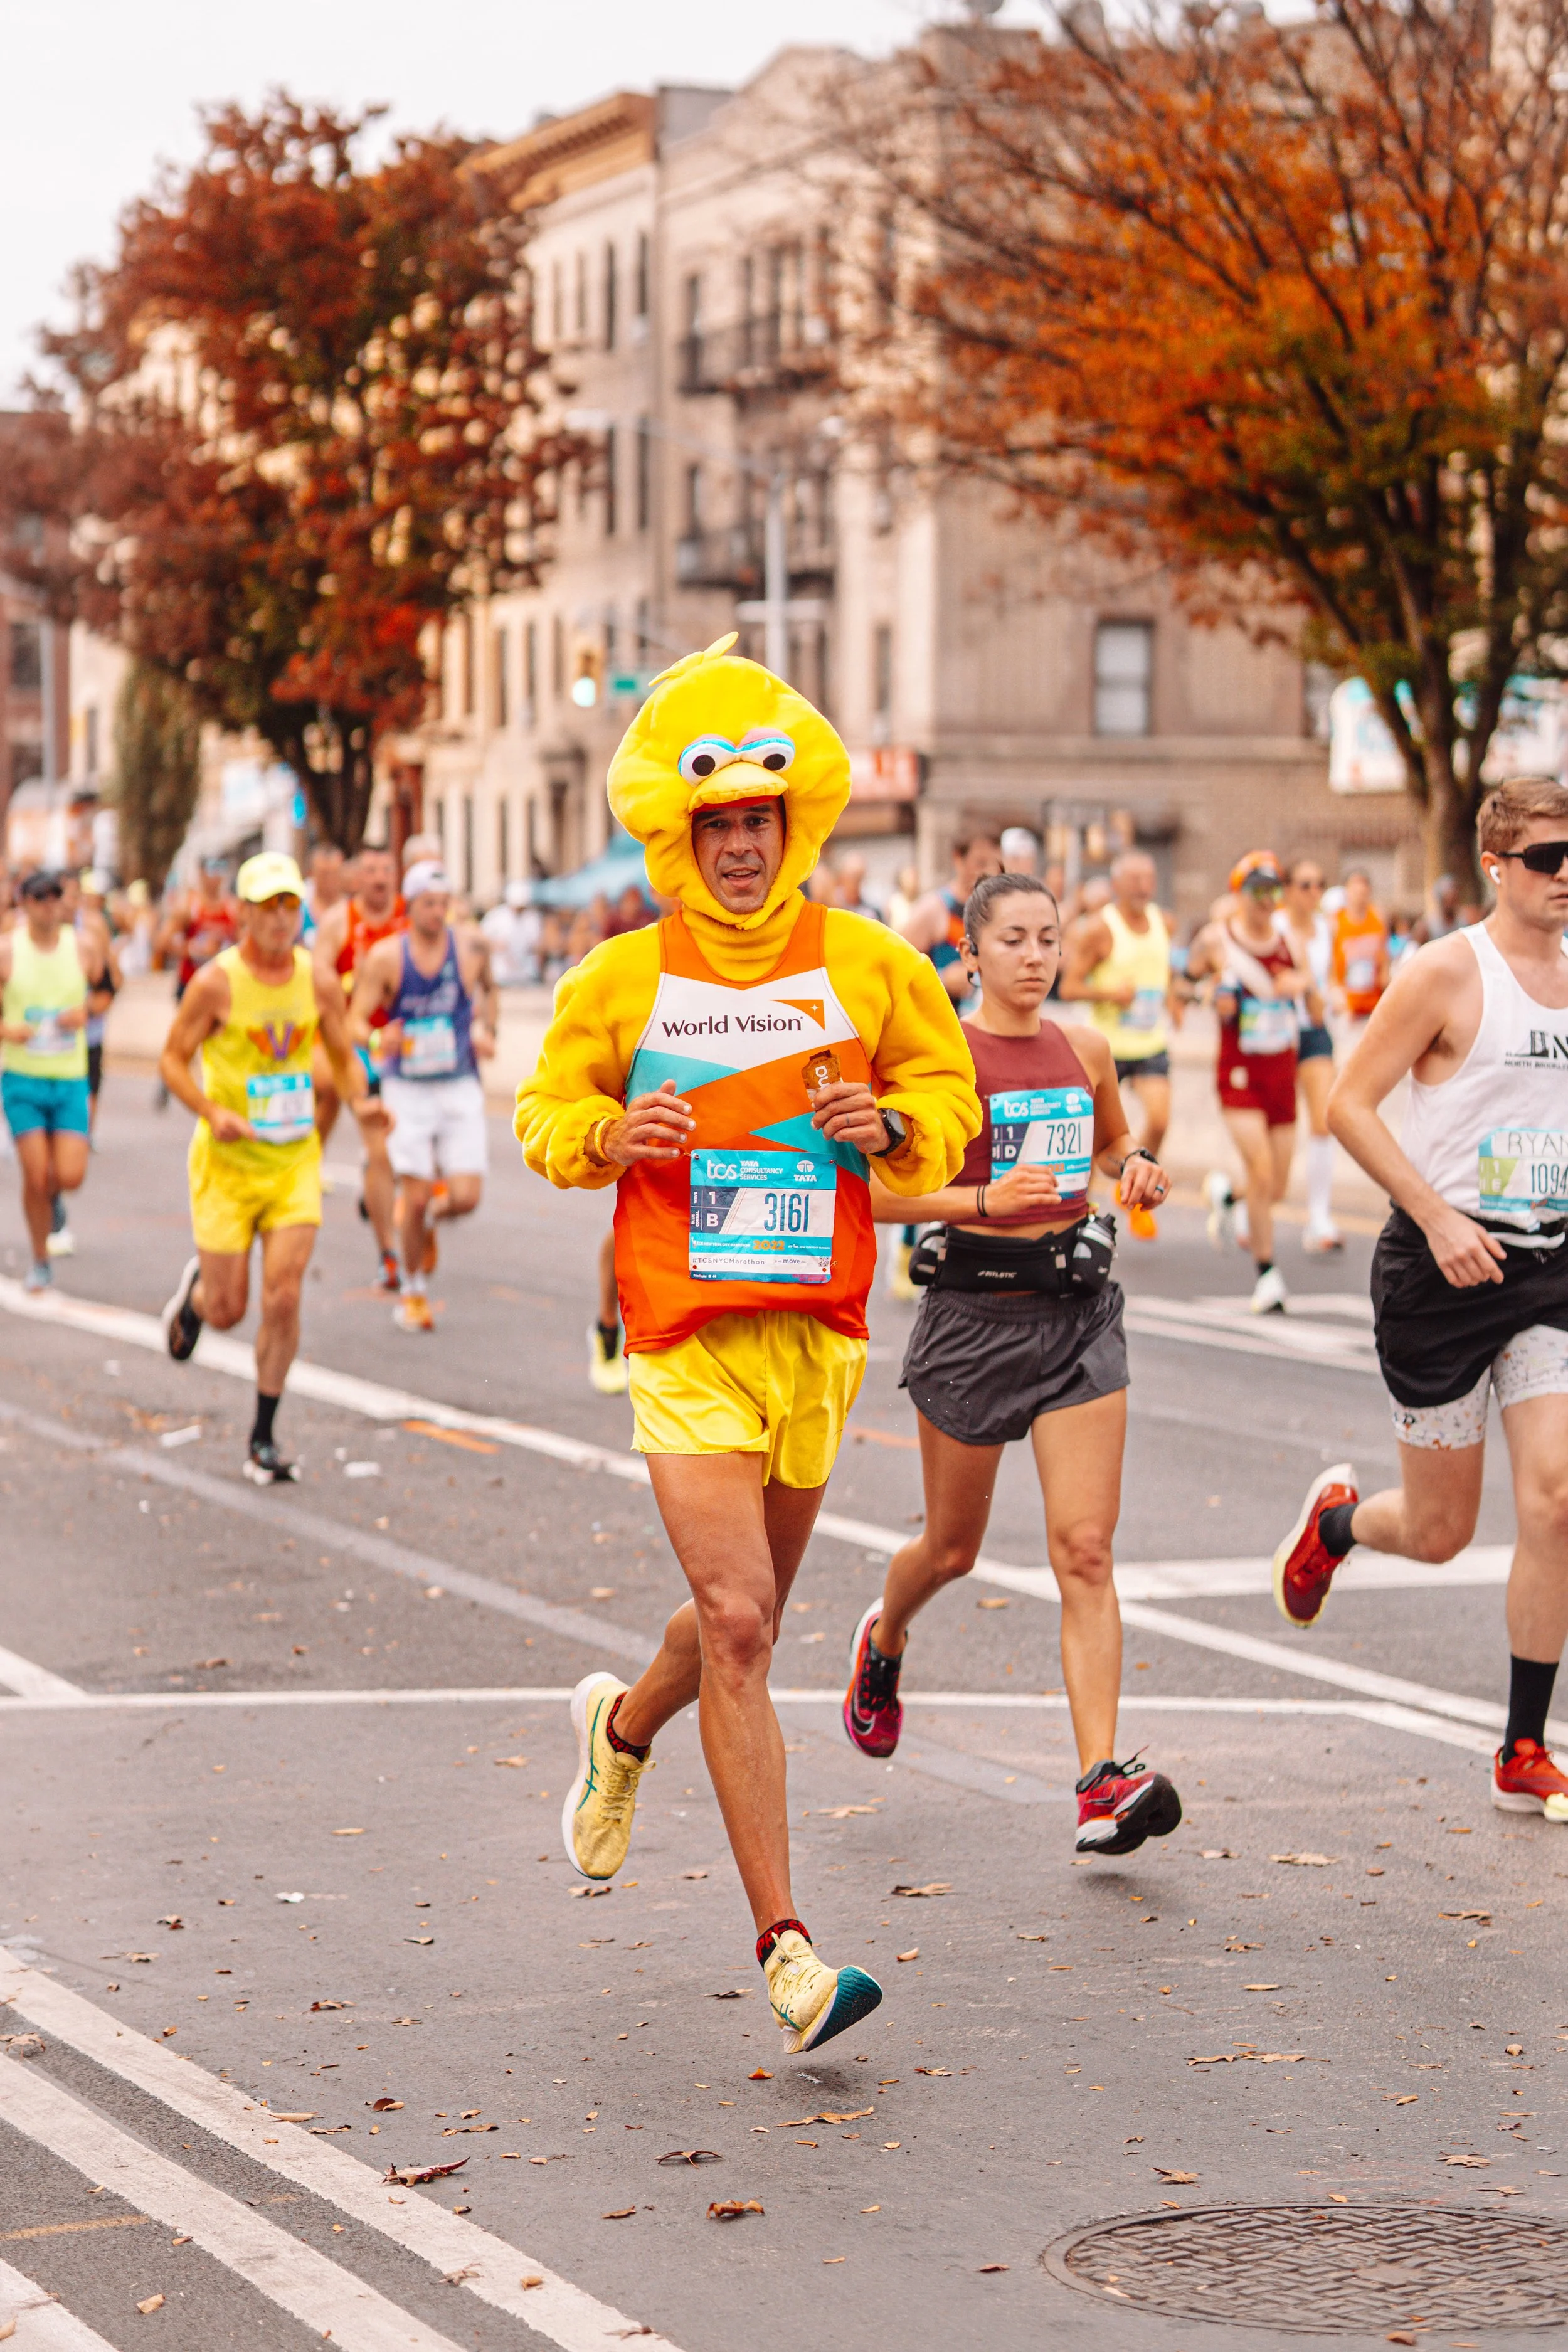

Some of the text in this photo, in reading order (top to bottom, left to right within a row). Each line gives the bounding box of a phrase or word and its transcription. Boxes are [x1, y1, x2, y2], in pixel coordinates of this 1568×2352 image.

[662, 1014, 802, 1037] World Vision
[1004, 1100, 1029, 1118] tcs
[1007, 1126, 1013, 1140] 1
[1047, 1122, 1081, 1156] 7321
[1005, 1144, 1016, 1158] D
[707, 1159, 737, 1180] tcs
[793, 1174, 817, 1182] TATA
[709, 1191, 716, 1205] 1
[707, 1213, 719, 1227] B
[763, 1192, 810, 1232] 3161
[753, 1239, 785, 1251] 2022
